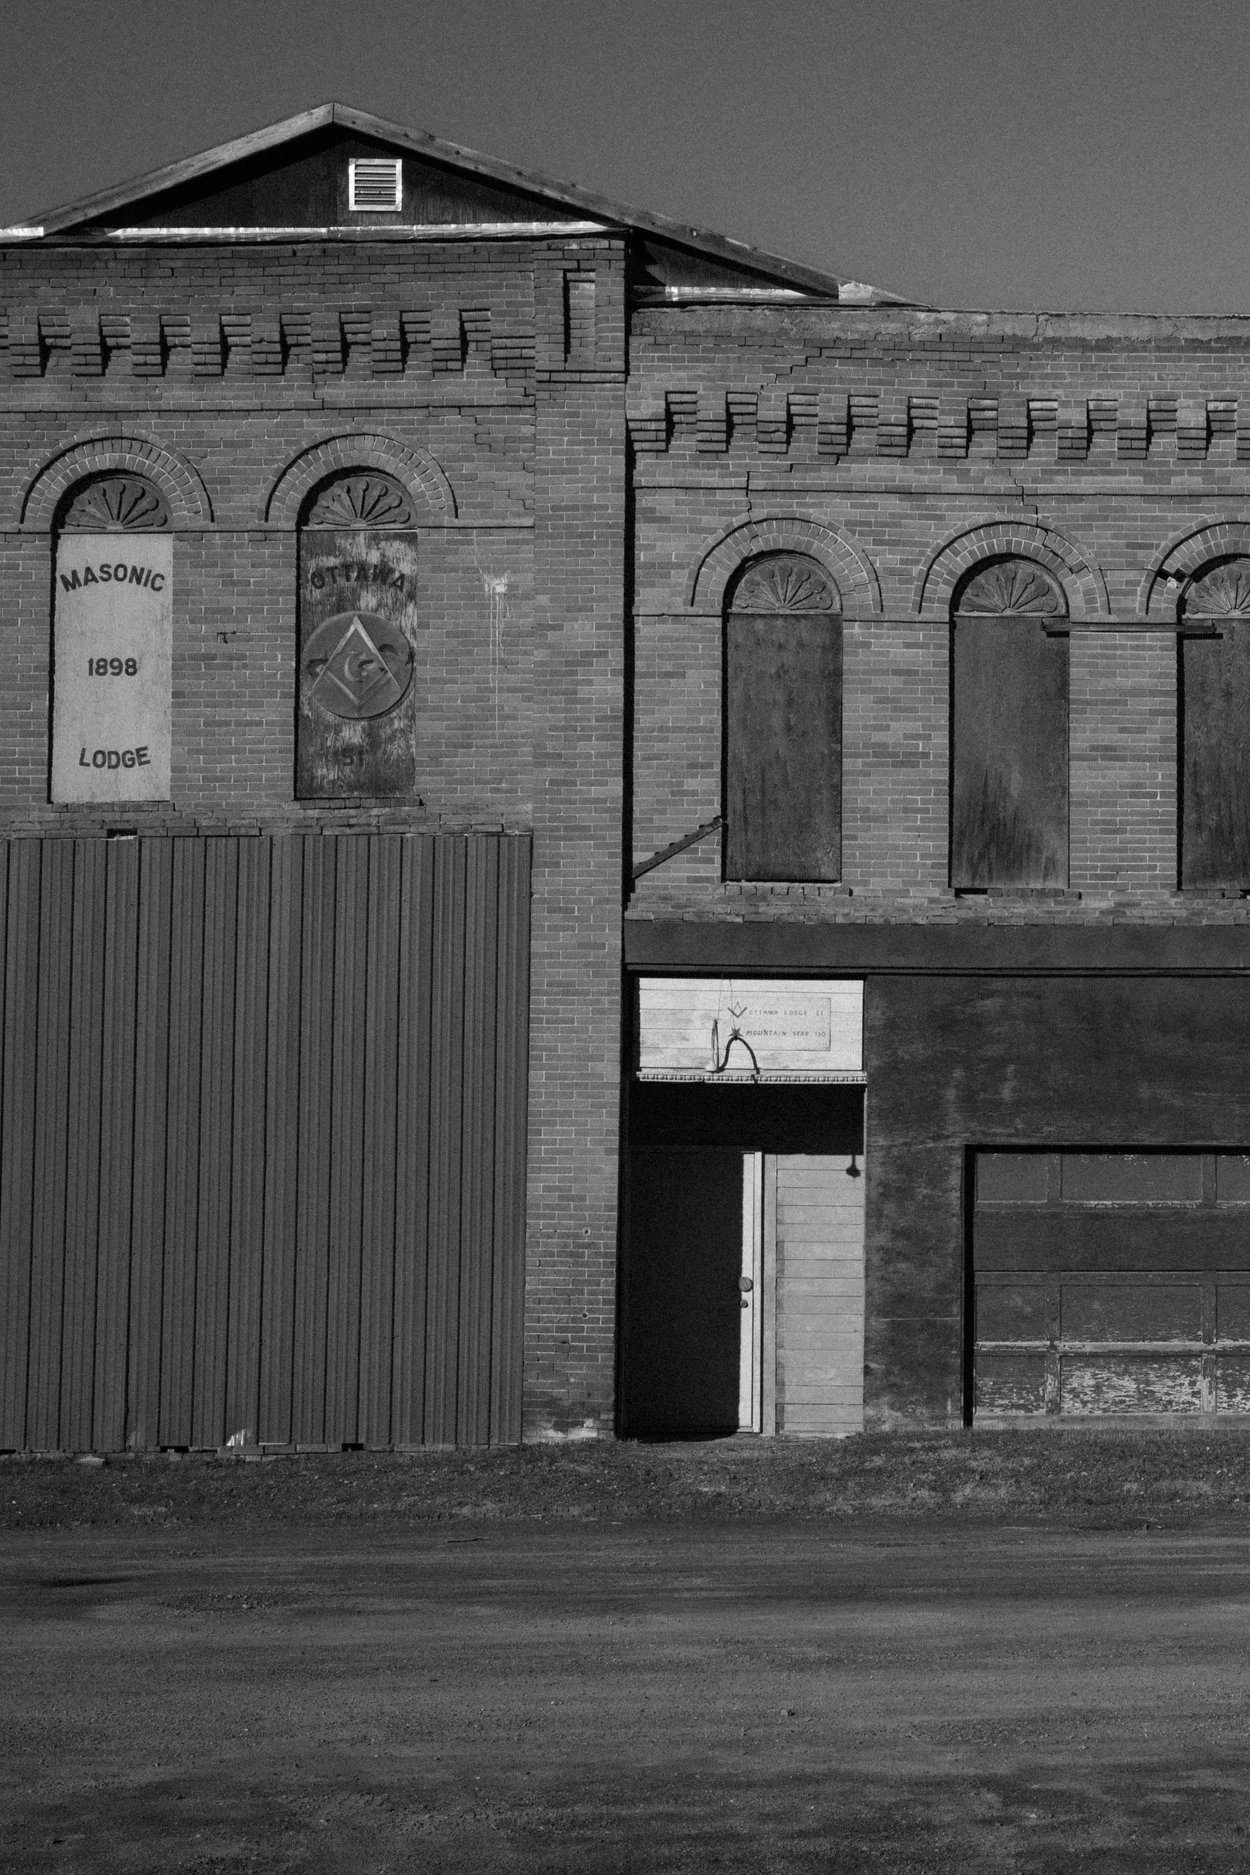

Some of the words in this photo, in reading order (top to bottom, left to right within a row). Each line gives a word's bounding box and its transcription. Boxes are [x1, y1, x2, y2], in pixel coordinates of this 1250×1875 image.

[60, 563, 166, 592] MASONIC
[310, 562, 405, 592] OTTAWA
[87, 657, 138, 677] 1898
[79, 746, 151, 769] LODGE
[783, 1009, 808, 1017] LODGE
[745, 1029, 787, 1037] MOUNTAIN
